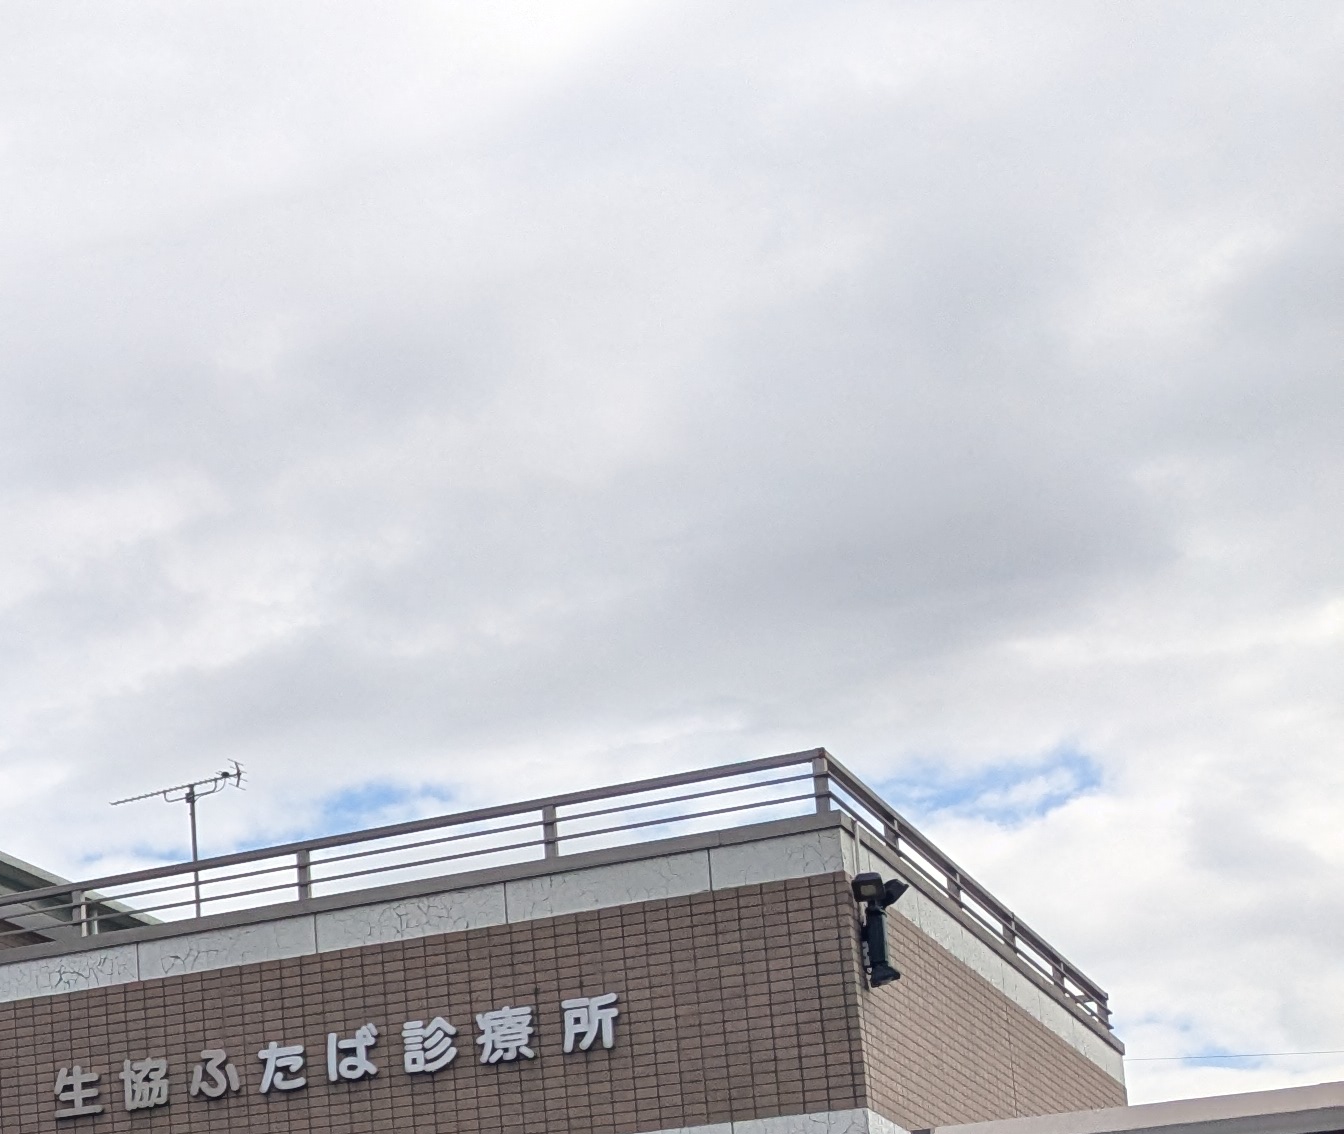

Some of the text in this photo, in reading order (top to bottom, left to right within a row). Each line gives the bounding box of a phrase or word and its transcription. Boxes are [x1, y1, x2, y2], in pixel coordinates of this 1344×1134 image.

[52, 991, 620, 1121] 生協ふたば診療所
